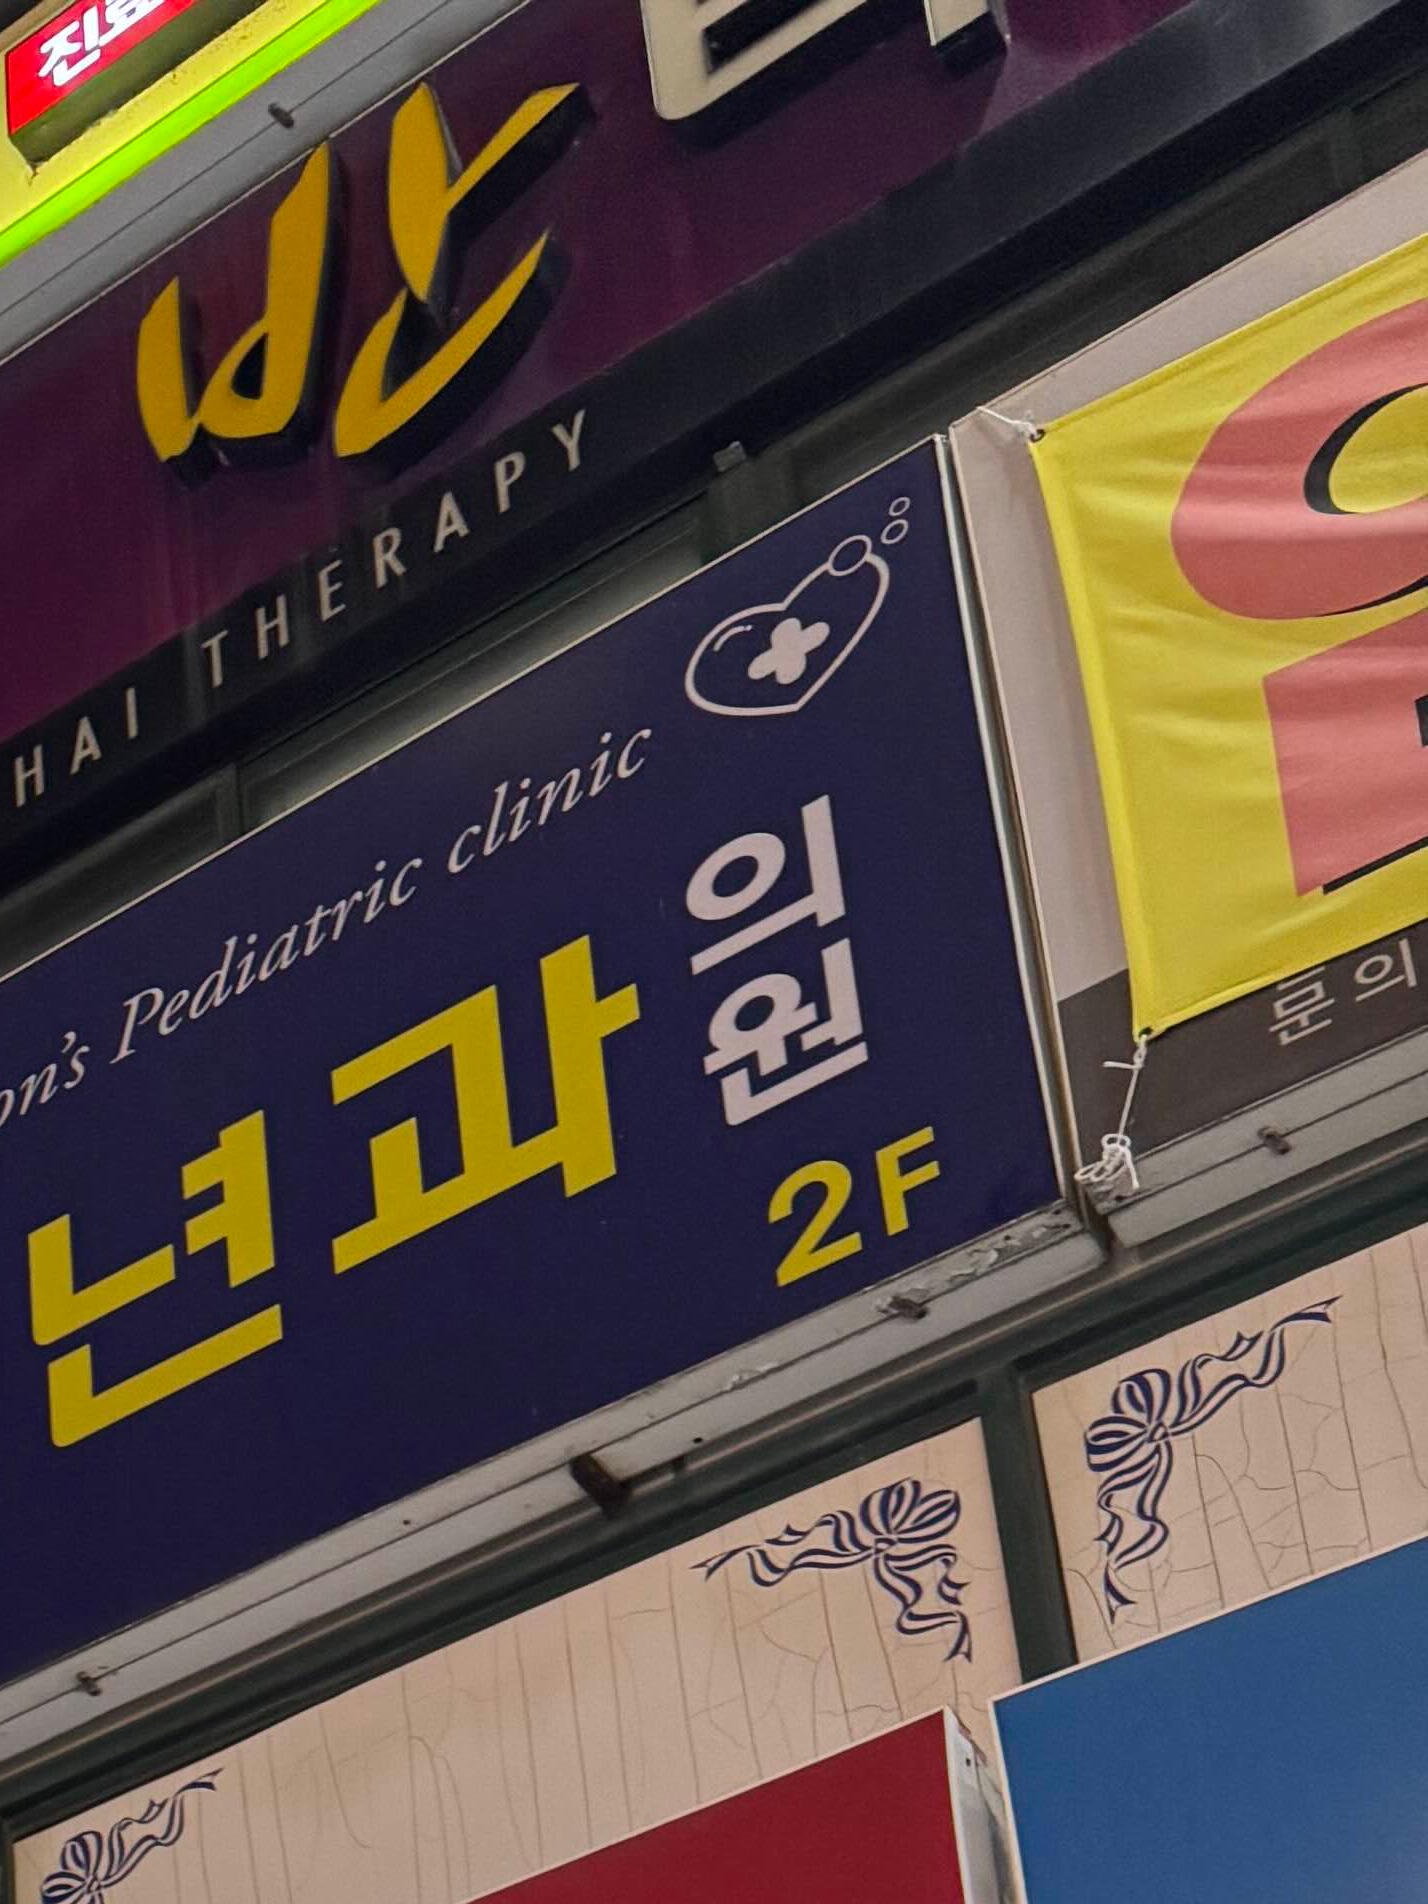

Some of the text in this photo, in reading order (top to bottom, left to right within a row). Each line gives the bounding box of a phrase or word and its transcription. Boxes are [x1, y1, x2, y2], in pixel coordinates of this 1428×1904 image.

[201, 408, 590, 690] THERAPY
[110, 851, 423, 1065] Pediatric
[446, 725, 652, 876] clinic
[685, 794, 868, 1127] 의원
[766, 1124, 942, 1288] 2F
